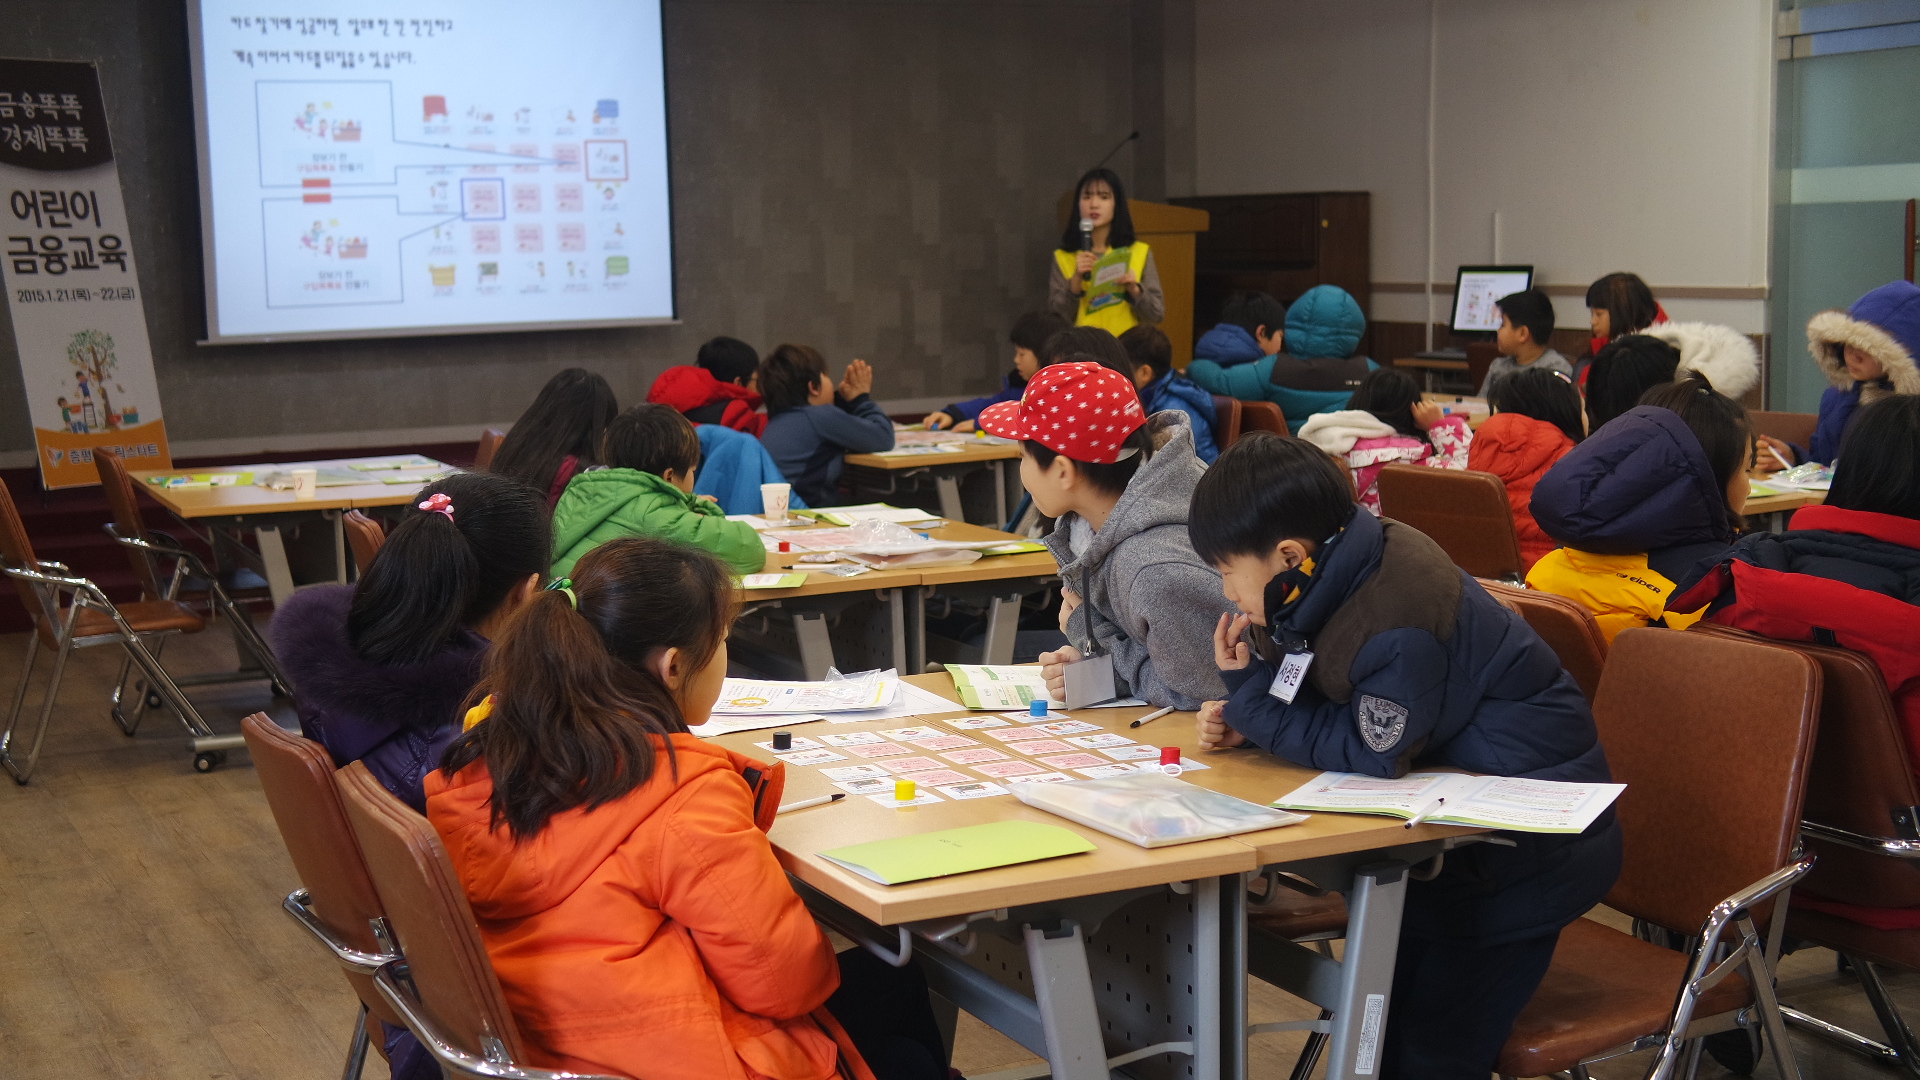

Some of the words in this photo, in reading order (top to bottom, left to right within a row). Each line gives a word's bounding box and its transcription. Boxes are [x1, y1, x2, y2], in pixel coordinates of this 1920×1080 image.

[0, 91, 83, 121] 금융똑똑
[2, 124, 89, 153] 경제똑똑
[10, 189, 102, 228] 어린이
[8, 234, 128, 275] 금융교육
